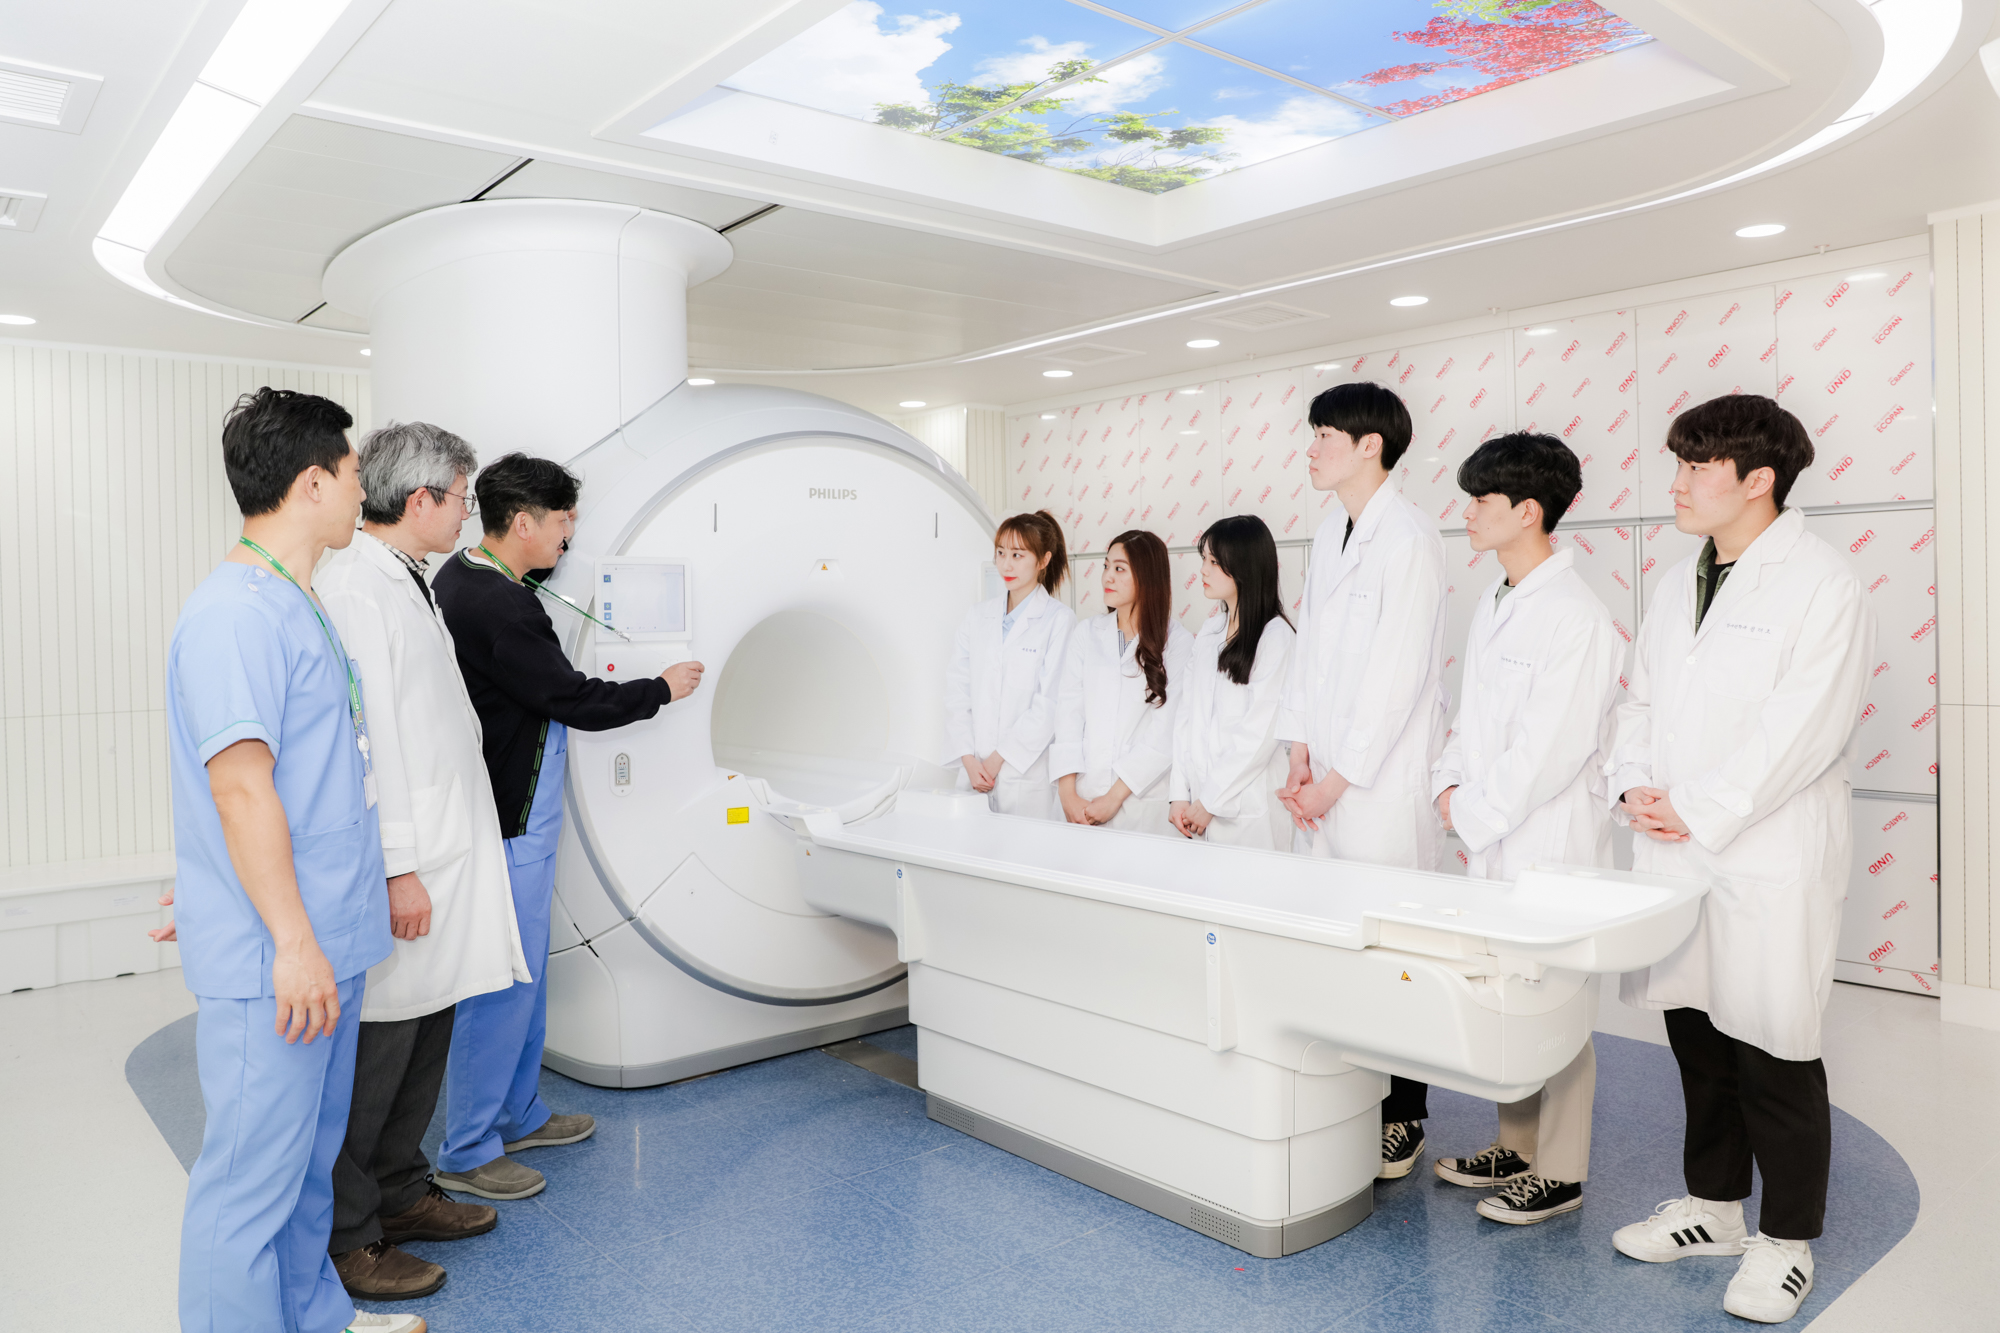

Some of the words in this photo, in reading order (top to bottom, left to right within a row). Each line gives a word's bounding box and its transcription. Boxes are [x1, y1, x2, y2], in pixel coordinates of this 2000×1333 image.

[1889, 271, 1913, 297] CRATECH
[1664, 309, 1687, 336] ECOPAN
[1718, 302, 1739, 326] CRATECH
[1815, 327, 1838, 351] CRATECH
[1874, 316, 1903, 345] ECOPAN
[1561, 339, 1580, 362] UNID
[1605, 331, 1627, 356] ECOPAN
[1478, 352, 1493, 371] CRATECH
[1656, 352, 1677, 375] CRATECH
[1707, 343, 1730, 368] UNID
[1399, 364, 1414, 384] UNID
[1436, 357, 1453, 379] ECOPAN
[1890, 361, 1915, 386] CRATECH
[1572, 377, 1591, 398] CRATECH
[1618, 369, 1637, 393] UNID
[1220, 395, 1232, 414] UNID
[1430, 394, 1445, 414] CRATECH
[1469, 388, 1487, 409] UNID
[1525, 382, 1545, 406] ECOPAN
[1666, 390, 1689, 415] ECOPAN
[1563, 415, 1582, 437] UNID
[1607, 409, 1629, 433] ECOPAN
[1816, 414, 1839, 437] CRATECH
[1876, 405, 1905, 433] ECOPAN
[1257, 422, 1270, 441] UNID
[1437, 427, 1456, 450] ECOPAN
[1222, 457, 1234, 476] UNID
[1620, 448, 1639, 471] UNID
[1891, 451, 1917, 475] CRATECH
[1432, 464, 1447, 484] CRATECH
[809, 487, 857, 501] PHILIPS
[1258, 486, 1272, 504] UNID
[1609, 487, 1631, 511] ECOPAN
[1439, 498, 1457, 520] ECOPAN
[1284, 515, 1299, 534] ECOPAN
[1185, 573, 1198, 590] UNID
[1611, 571, 1631, 591] CRATECH
[1864, 749, 1889, 770] CRATECH
[1881, 811, 1907, 832] CRATECH
[1882, 900, 1907, 920] CRATECH
[1537, 1032, 1566, 1054] PHILIPS
